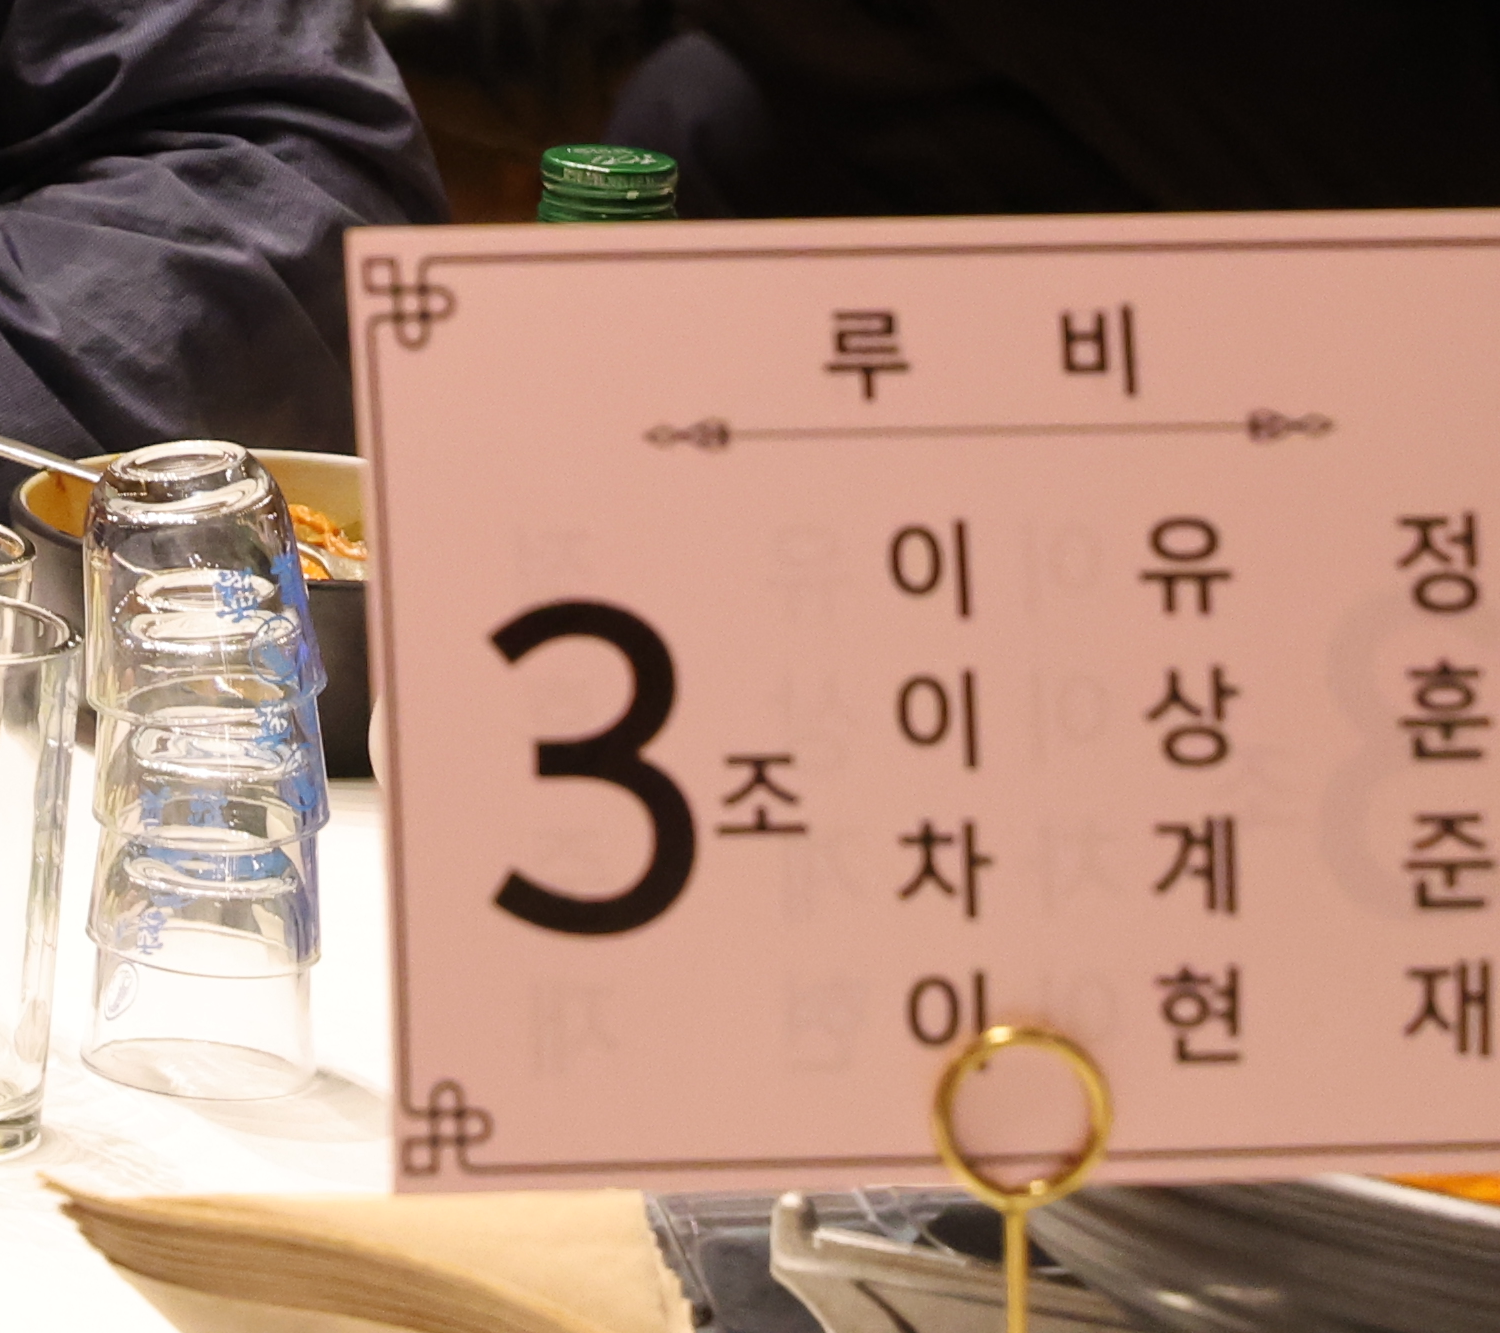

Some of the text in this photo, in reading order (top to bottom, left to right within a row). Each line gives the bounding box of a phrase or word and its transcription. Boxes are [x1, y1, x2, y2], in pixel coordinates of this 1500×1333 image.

[826, 304, 1138, 401] 루 비
[889, 512, 1479, 619] 이 유 정
[896, 659, 1490, 769] 이 상 훈
[900, 813, 1495, 920] 차 계 준
[907, 959, 1493, 1071] 이 현 재
